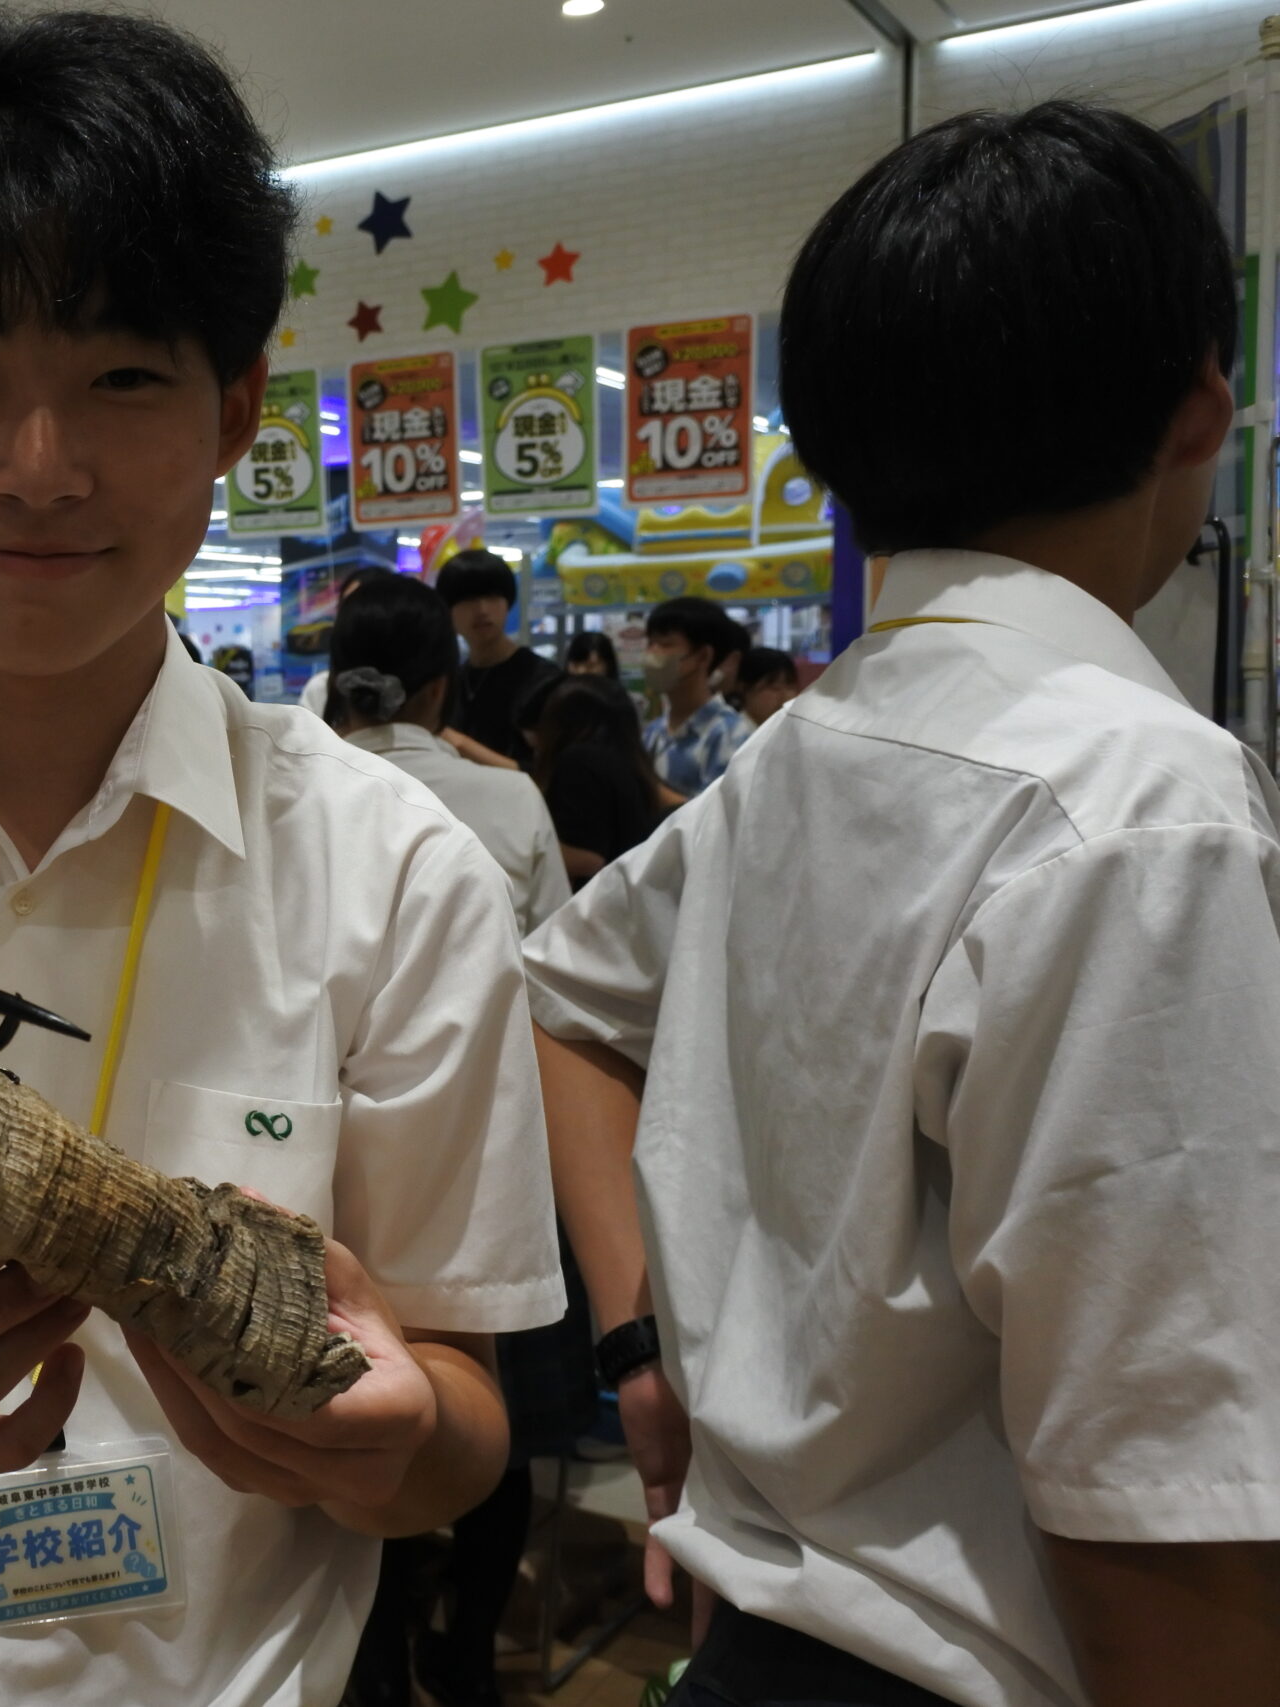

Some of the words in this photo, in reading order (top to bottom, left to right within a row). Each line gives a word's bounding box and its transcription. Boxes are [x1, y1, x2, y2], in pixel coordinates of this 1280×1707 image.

[653, 376, 723, 412] 現金
[373, 407, 432, 441] 現金
[636, 414, 738, 469] 10%
[701, 450, 738, 467] OFF
[361, 443, 446, 493] 10%
[415, 475, 448, 491] OFF
[516, 440, 562, 478] 5%
[254, 465, 293, 499] 5%
